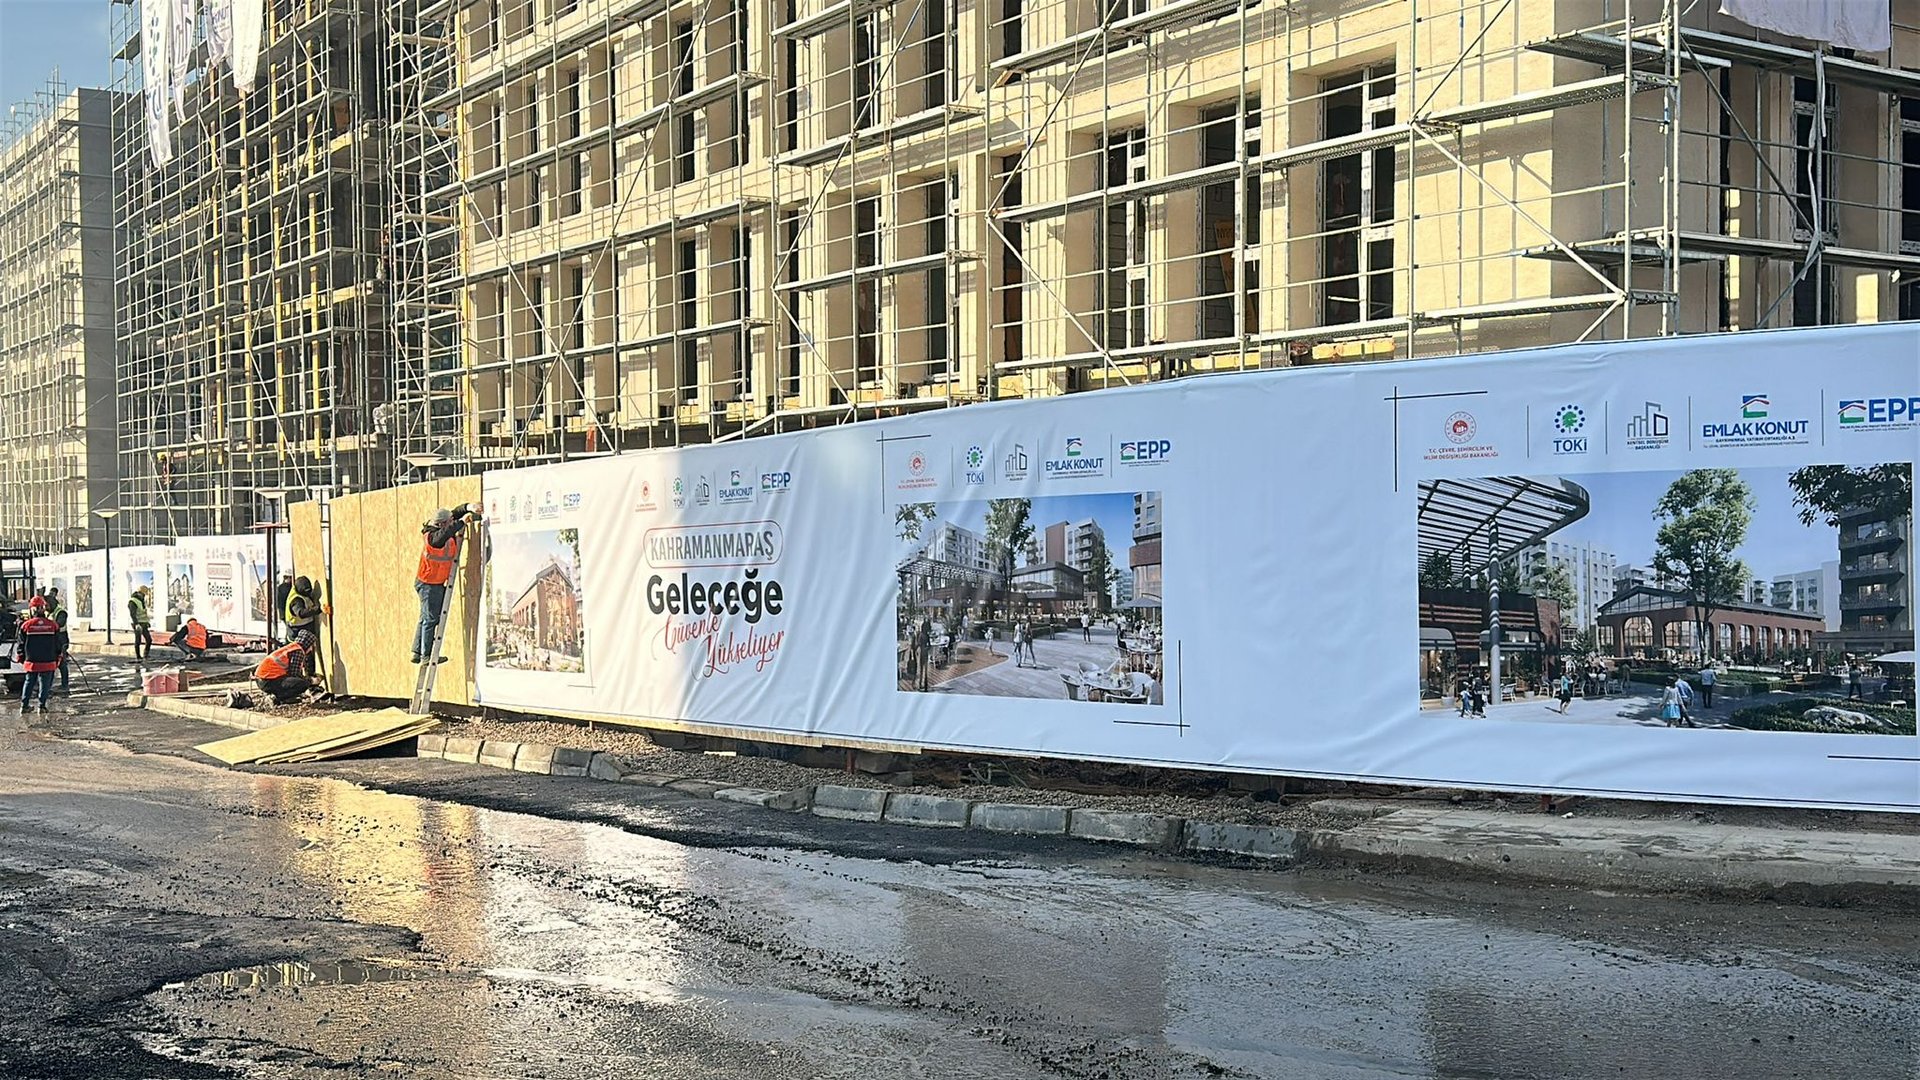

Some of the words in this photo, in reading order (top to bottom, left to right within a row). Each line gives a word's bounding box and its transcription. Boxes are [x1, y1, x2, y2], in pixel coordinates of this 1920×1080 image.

[1703, 422, 1753, 437] EMLAK
[1755, 420, 1809, 435] KONUT
[1137, 440, 1171, 460] EPP
[1553, 438, 1587, 452] TOKİ
[1045, 460, 1073, 471] EMLAK
[1074, 458, 1104, 469] KONUT
[771, 471, 791, 488] EPP
[650, 531, 774, 560] KAHRAMANMARAŞ
[646, 568, 784, 624] Geleceğe
[654, 603, 721, 659] Güvenle
[692, 626, 785, 681] Yükseliyor
